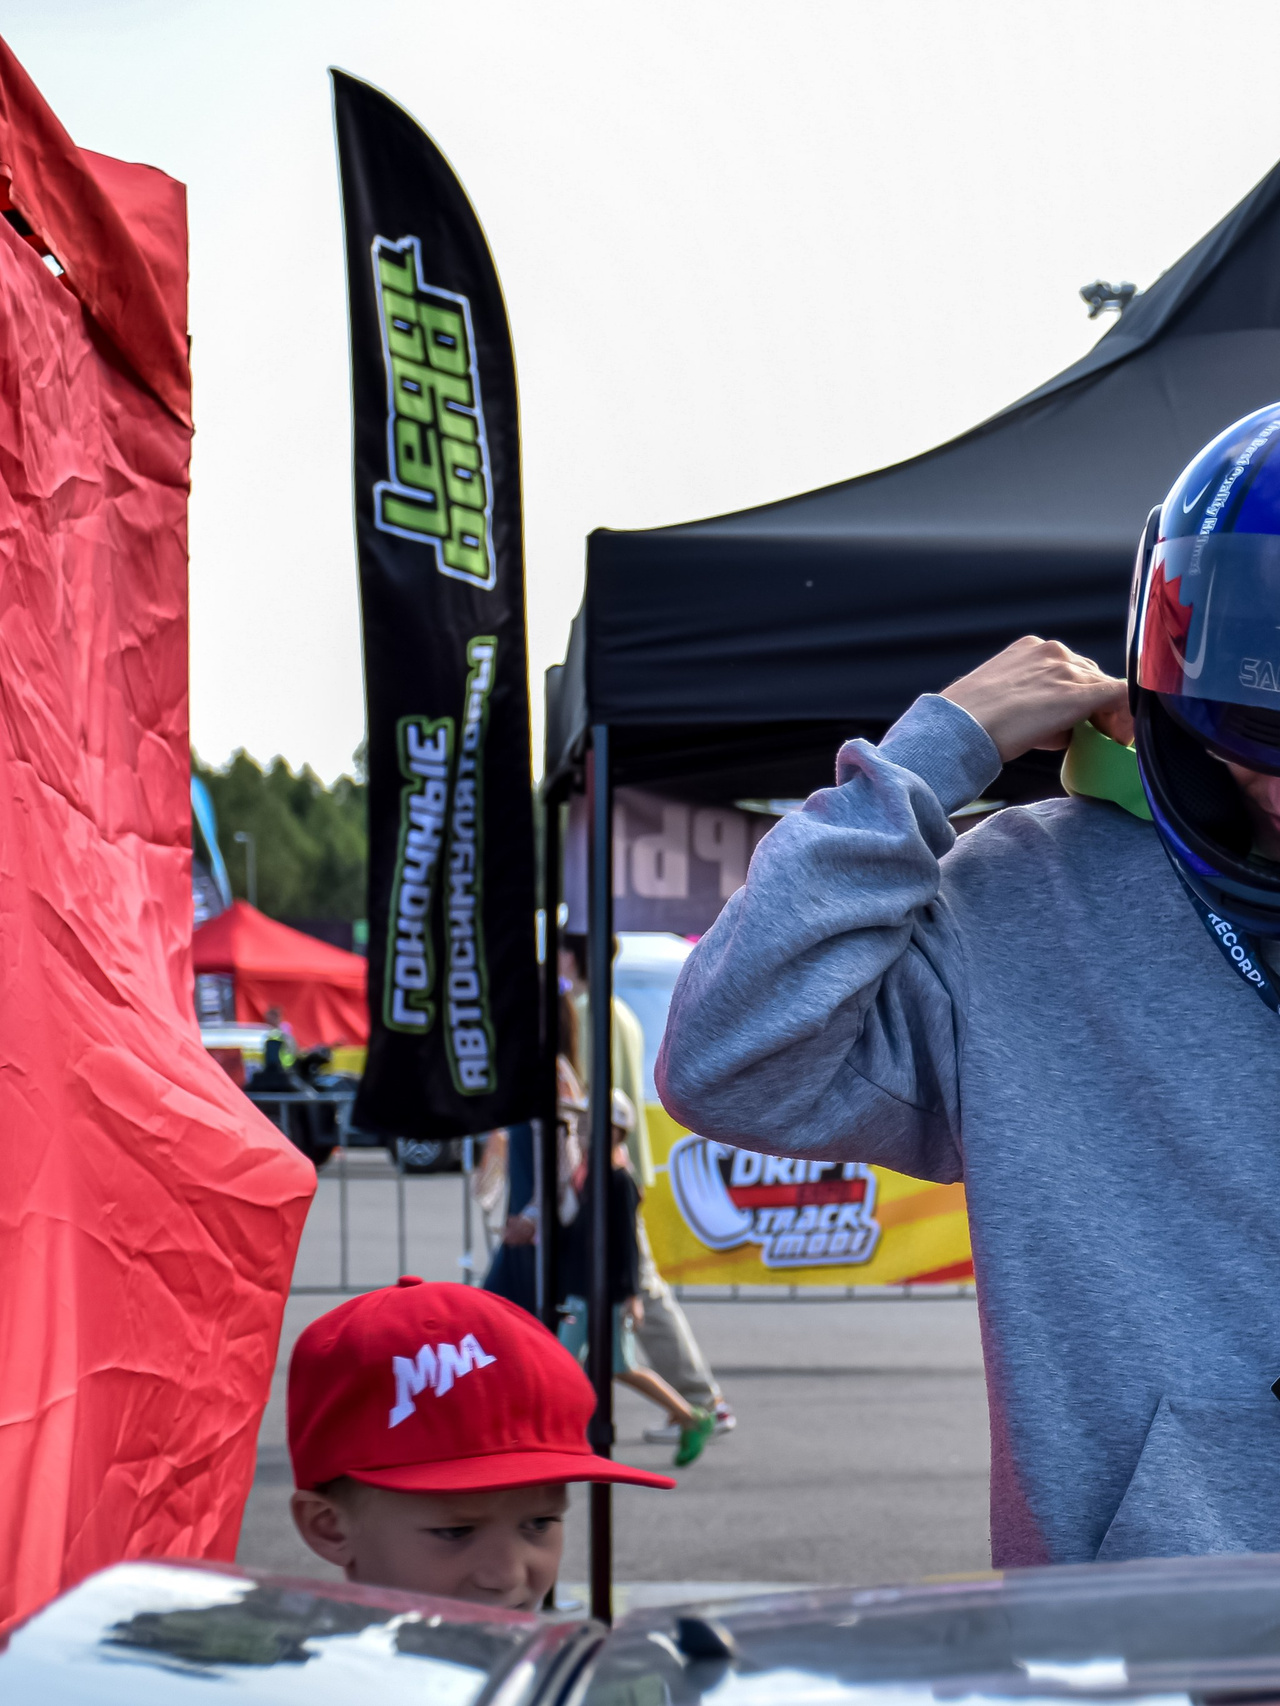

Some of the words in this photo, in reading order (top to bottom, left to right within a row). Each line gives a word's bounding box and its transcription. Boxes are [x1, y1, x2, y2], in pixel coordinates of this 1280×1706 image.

[1237, 437, 1268, 466] Best
[1206, 465, 1244, 517] Quality
[393, 722, 447, 1026] ГОНОЧНЫЕ
[756, 1203, 862, 1233] TRACK
